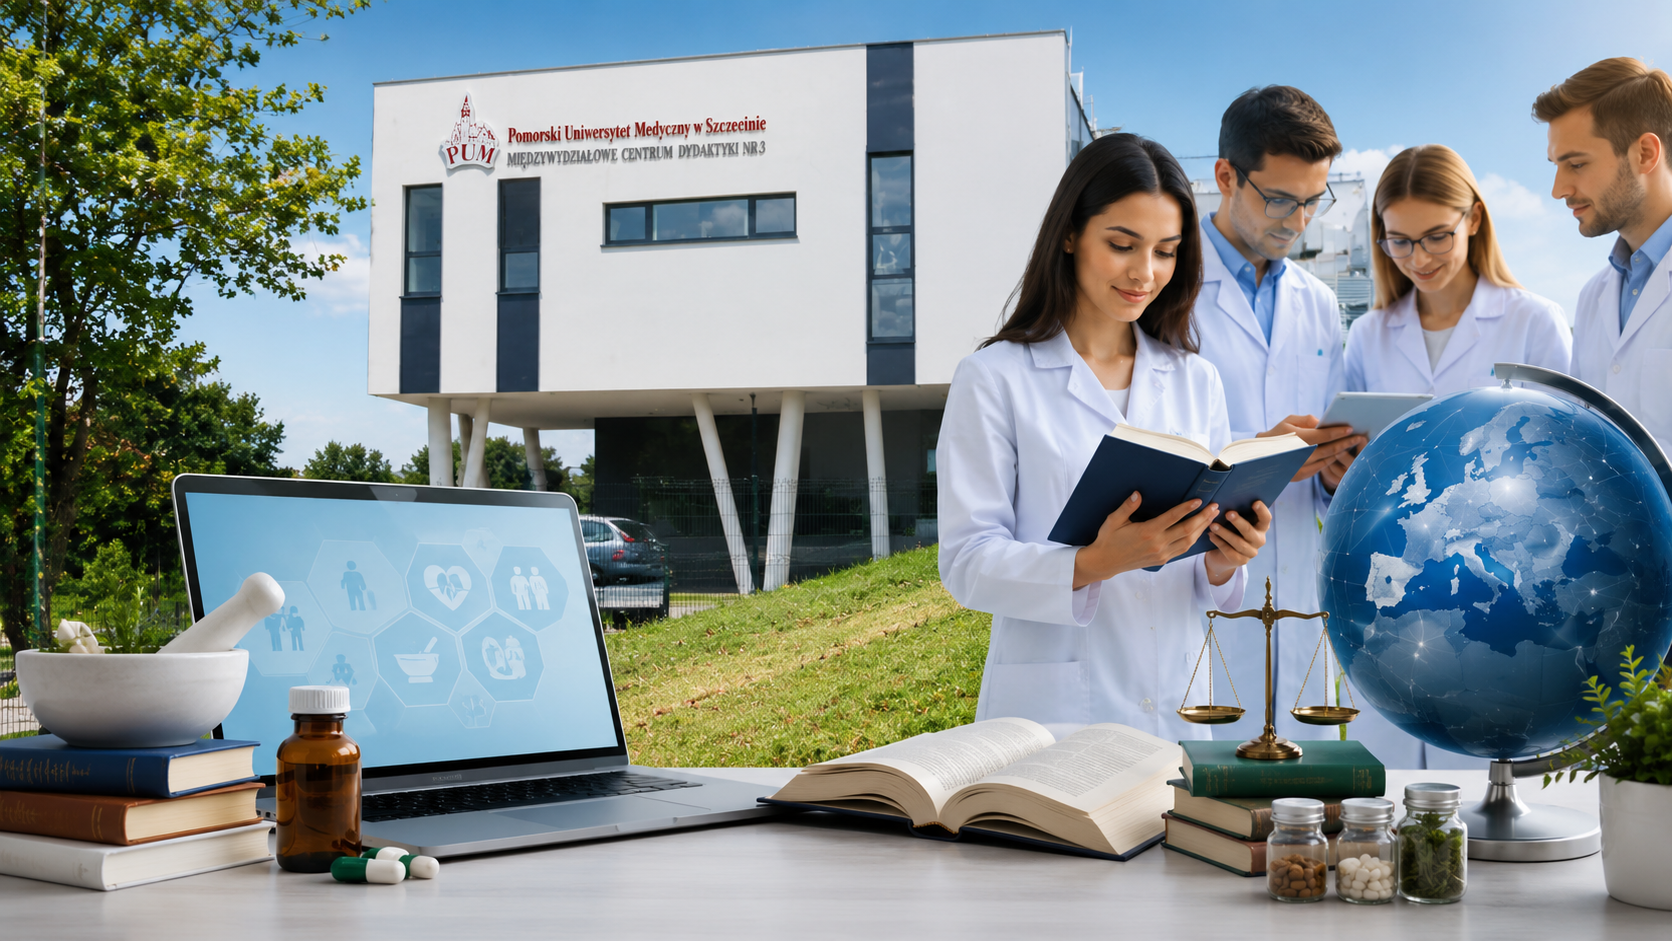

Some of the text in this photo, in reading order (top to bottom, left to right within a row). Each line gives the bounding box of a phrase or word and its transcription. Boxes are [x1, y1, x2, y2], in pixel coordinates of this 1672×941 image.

[507, 126, 561, 143] Pomorski
[564, 124, 631, 143] Uniwersytet
[634, 120, 691, 141] Medyczny
[693, 123, 703, 135] w
[446, 144, 496, 165] PUM
[507, 148, 618, 169] MIĘDZYWYDZIAŁOWE
[621, 145, 673, 161] CENTRUM
[678, 141, 739, 159] DYDAKTYKI
